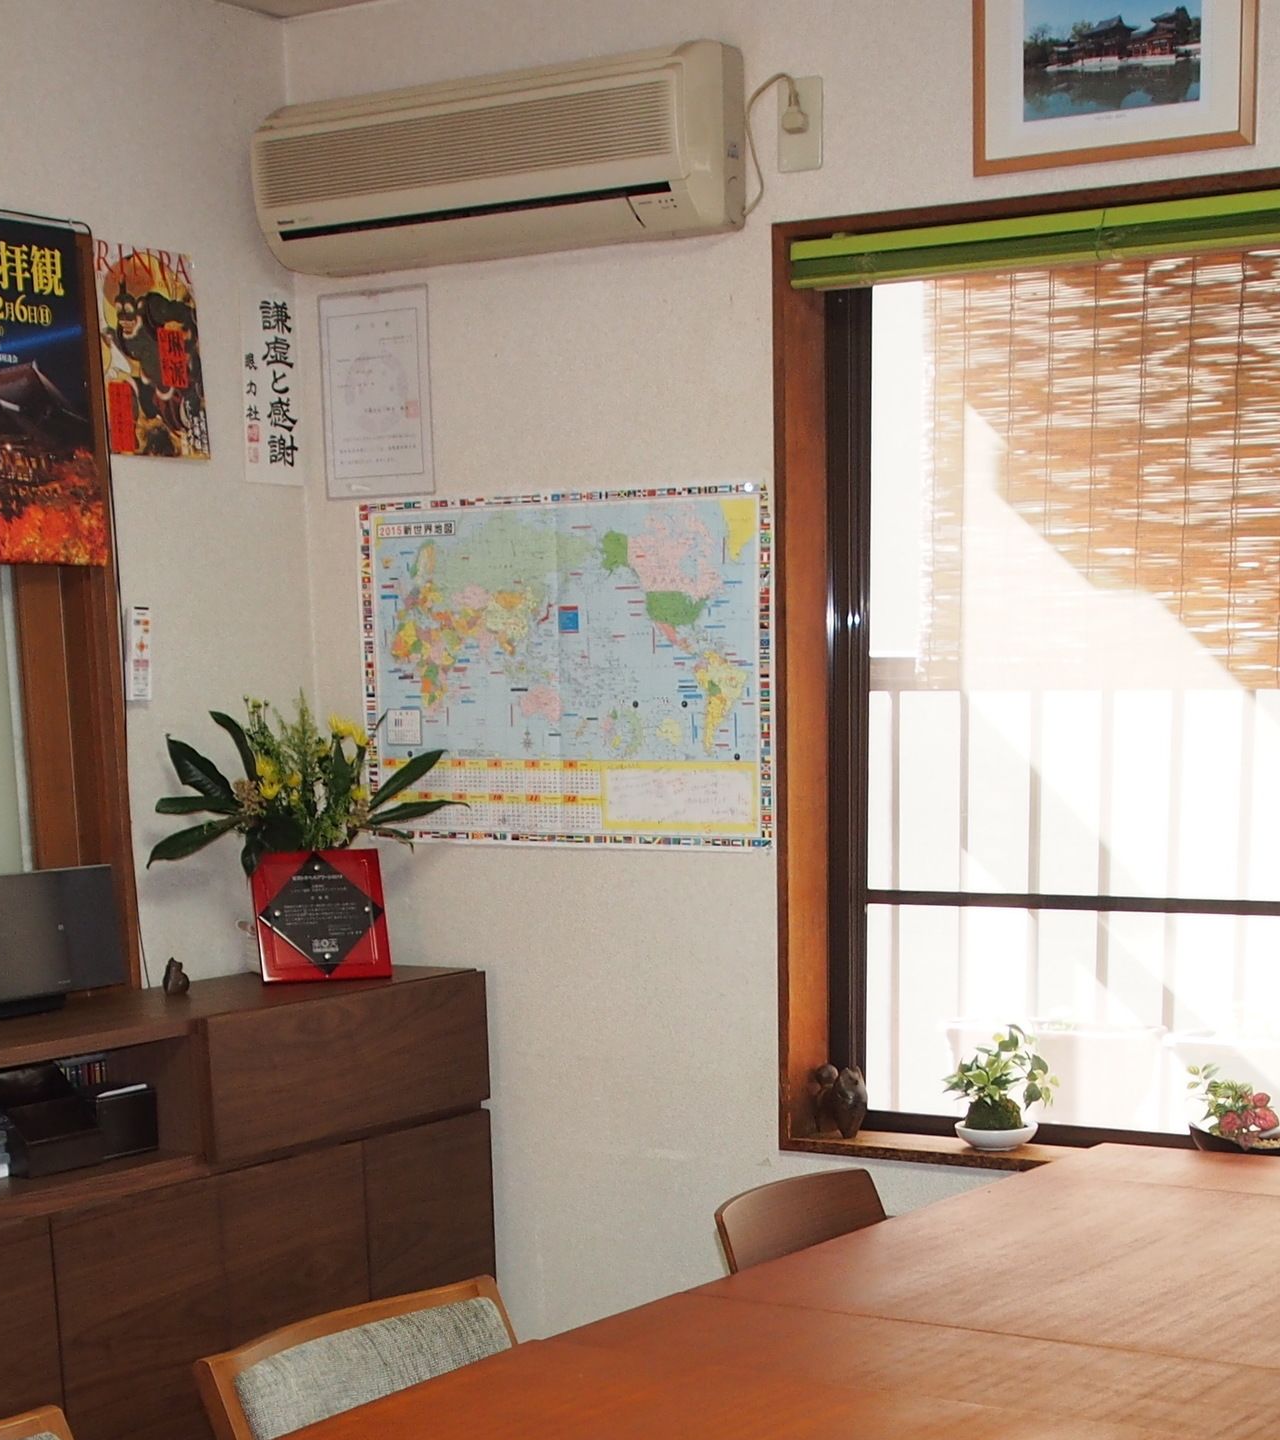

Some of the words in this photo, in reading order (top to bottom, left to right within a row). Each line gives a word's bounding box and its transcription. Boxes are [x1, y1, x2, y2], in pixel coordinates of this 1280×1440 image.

[244, 352, 261, 422] 眼力社
[259, 300, 299, 467] 謙虚と感謝
